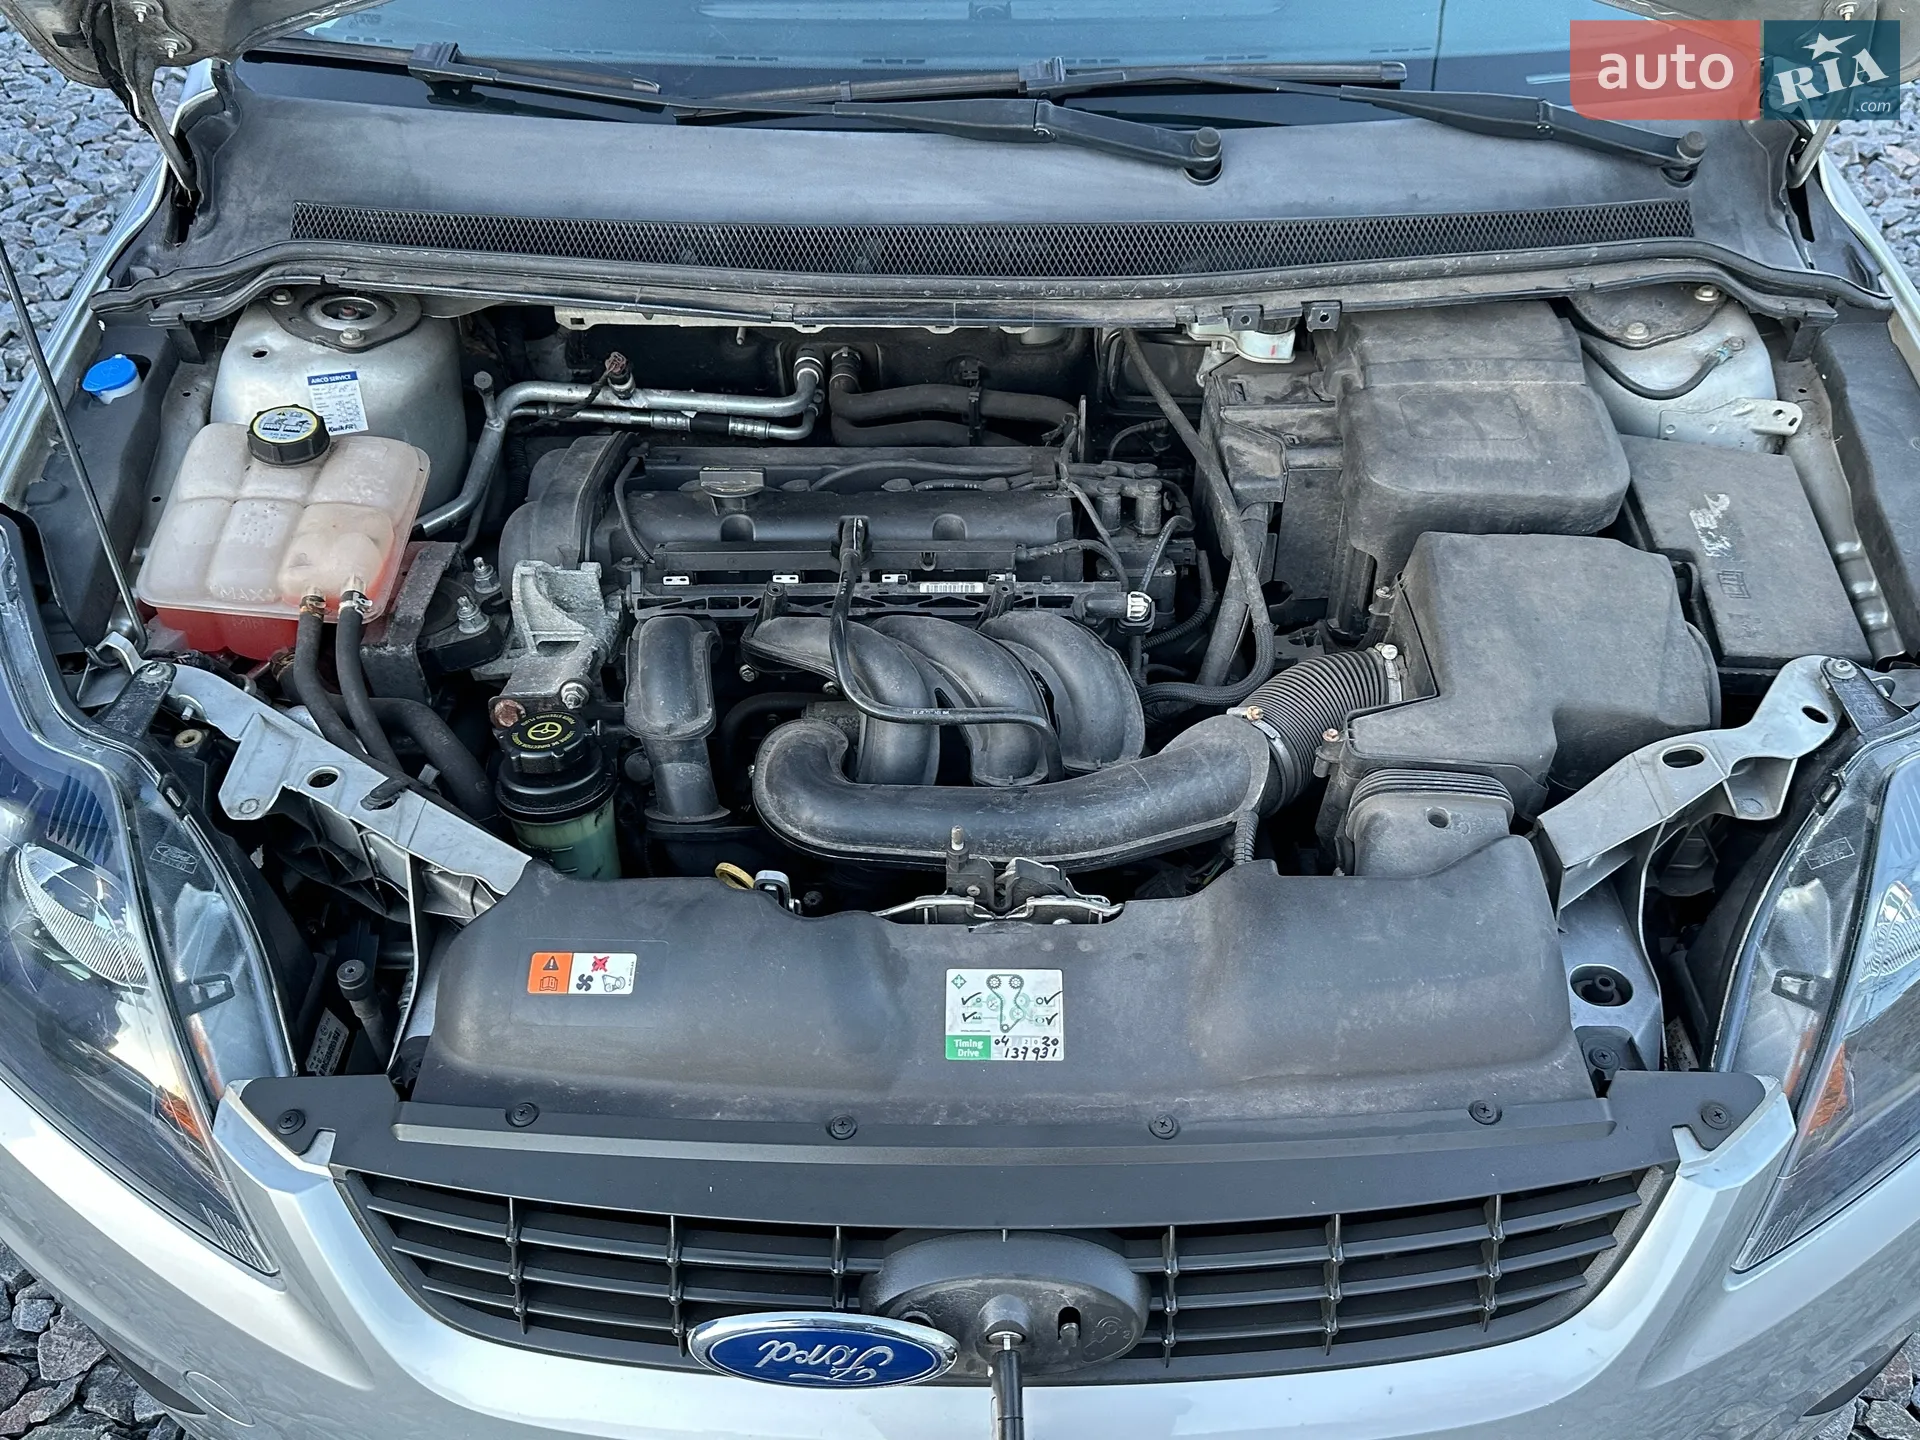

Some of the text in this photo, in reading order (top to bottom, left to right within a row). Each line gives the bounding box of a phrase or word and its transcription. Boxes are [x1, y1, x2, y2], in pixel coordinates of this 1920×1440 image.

[329, 374, 352, 382] SERVICE
[953, 1039, 984, 1049] Timing
[994, 1035, 1010, 1046] 04
[957, 1049, 980, 1058] Drive
[755, 1339, 895, 1381] Ford
